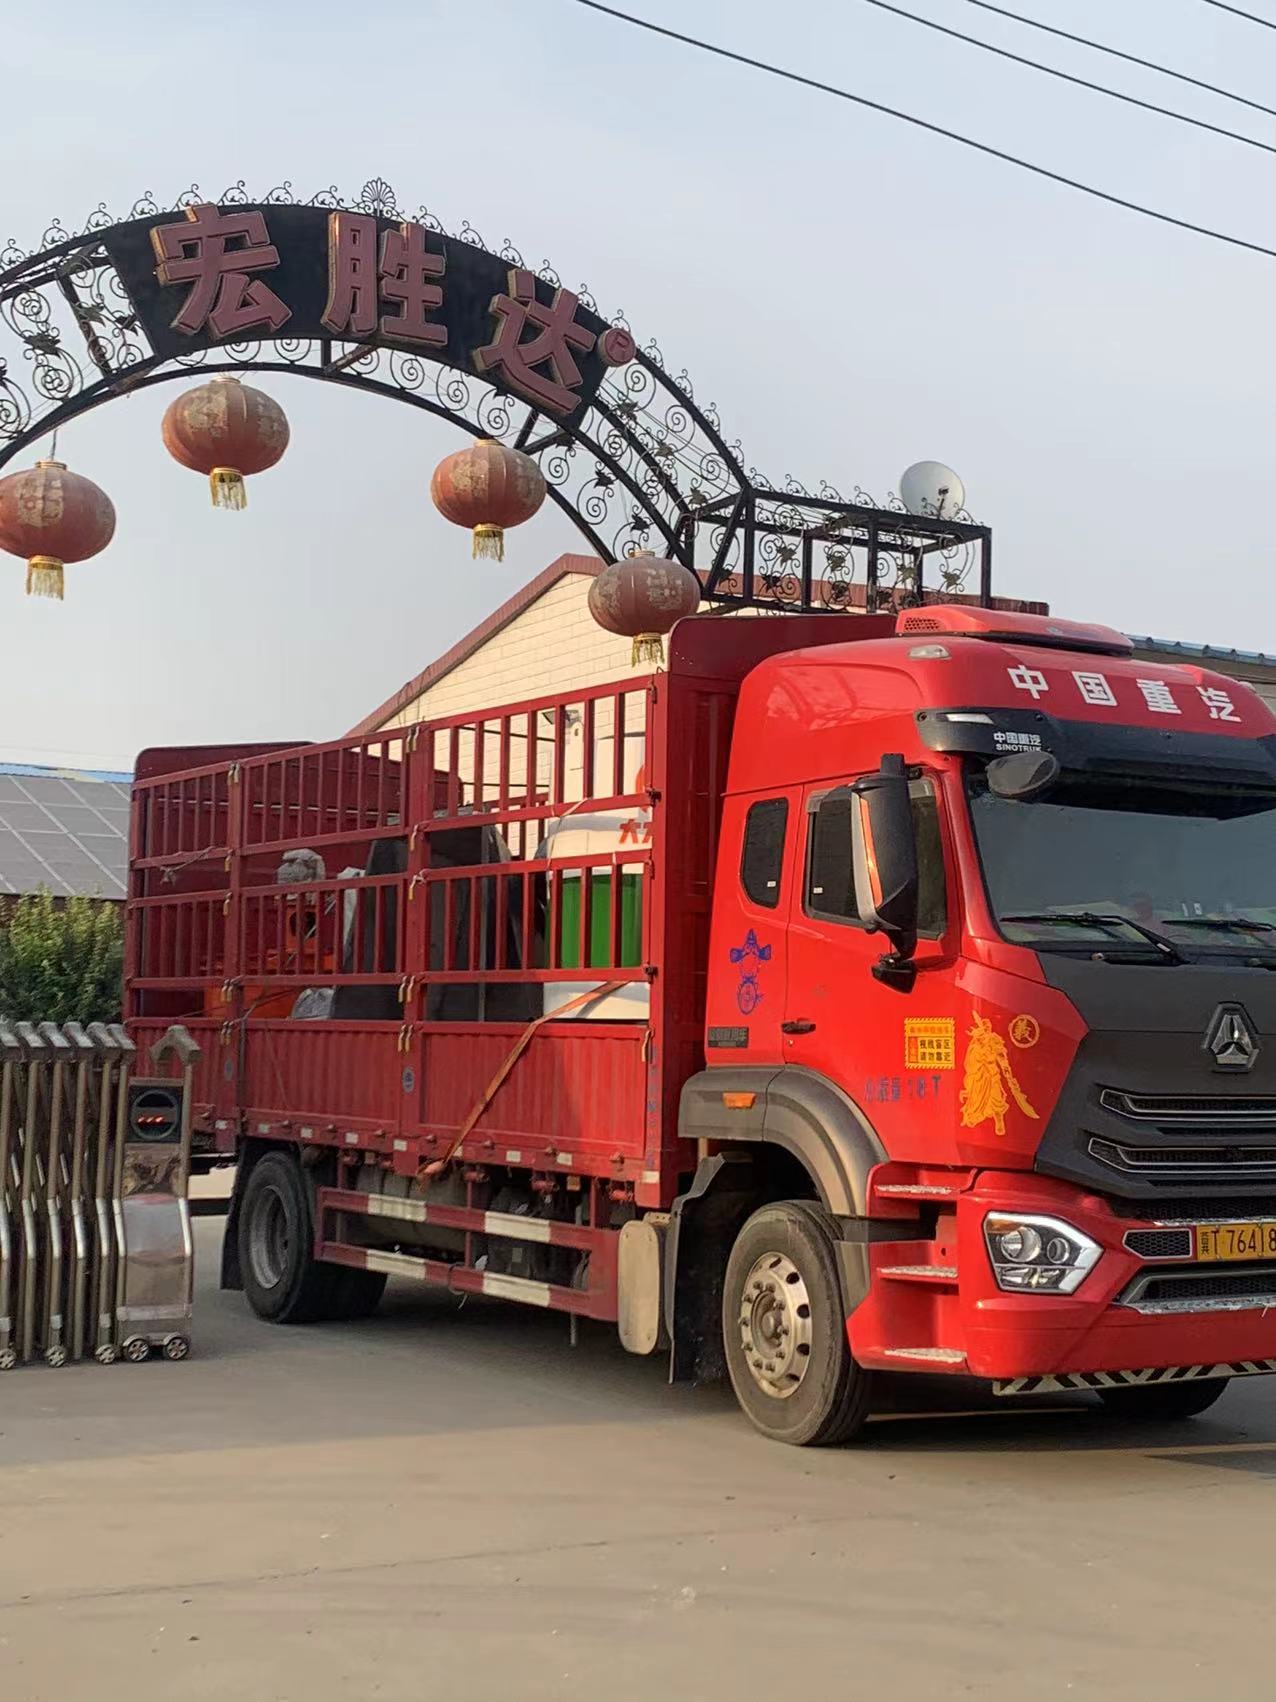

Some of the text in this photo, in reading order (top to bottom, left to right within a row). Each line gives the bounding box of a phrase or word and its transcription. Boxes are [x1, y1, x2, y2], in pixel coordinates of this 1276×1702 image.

[150, 202, 597, 413] 宏胜达
[1006, 664, 1242, 723] 中国重汽
[995, 743, 1042, 752] SINOTRUK
